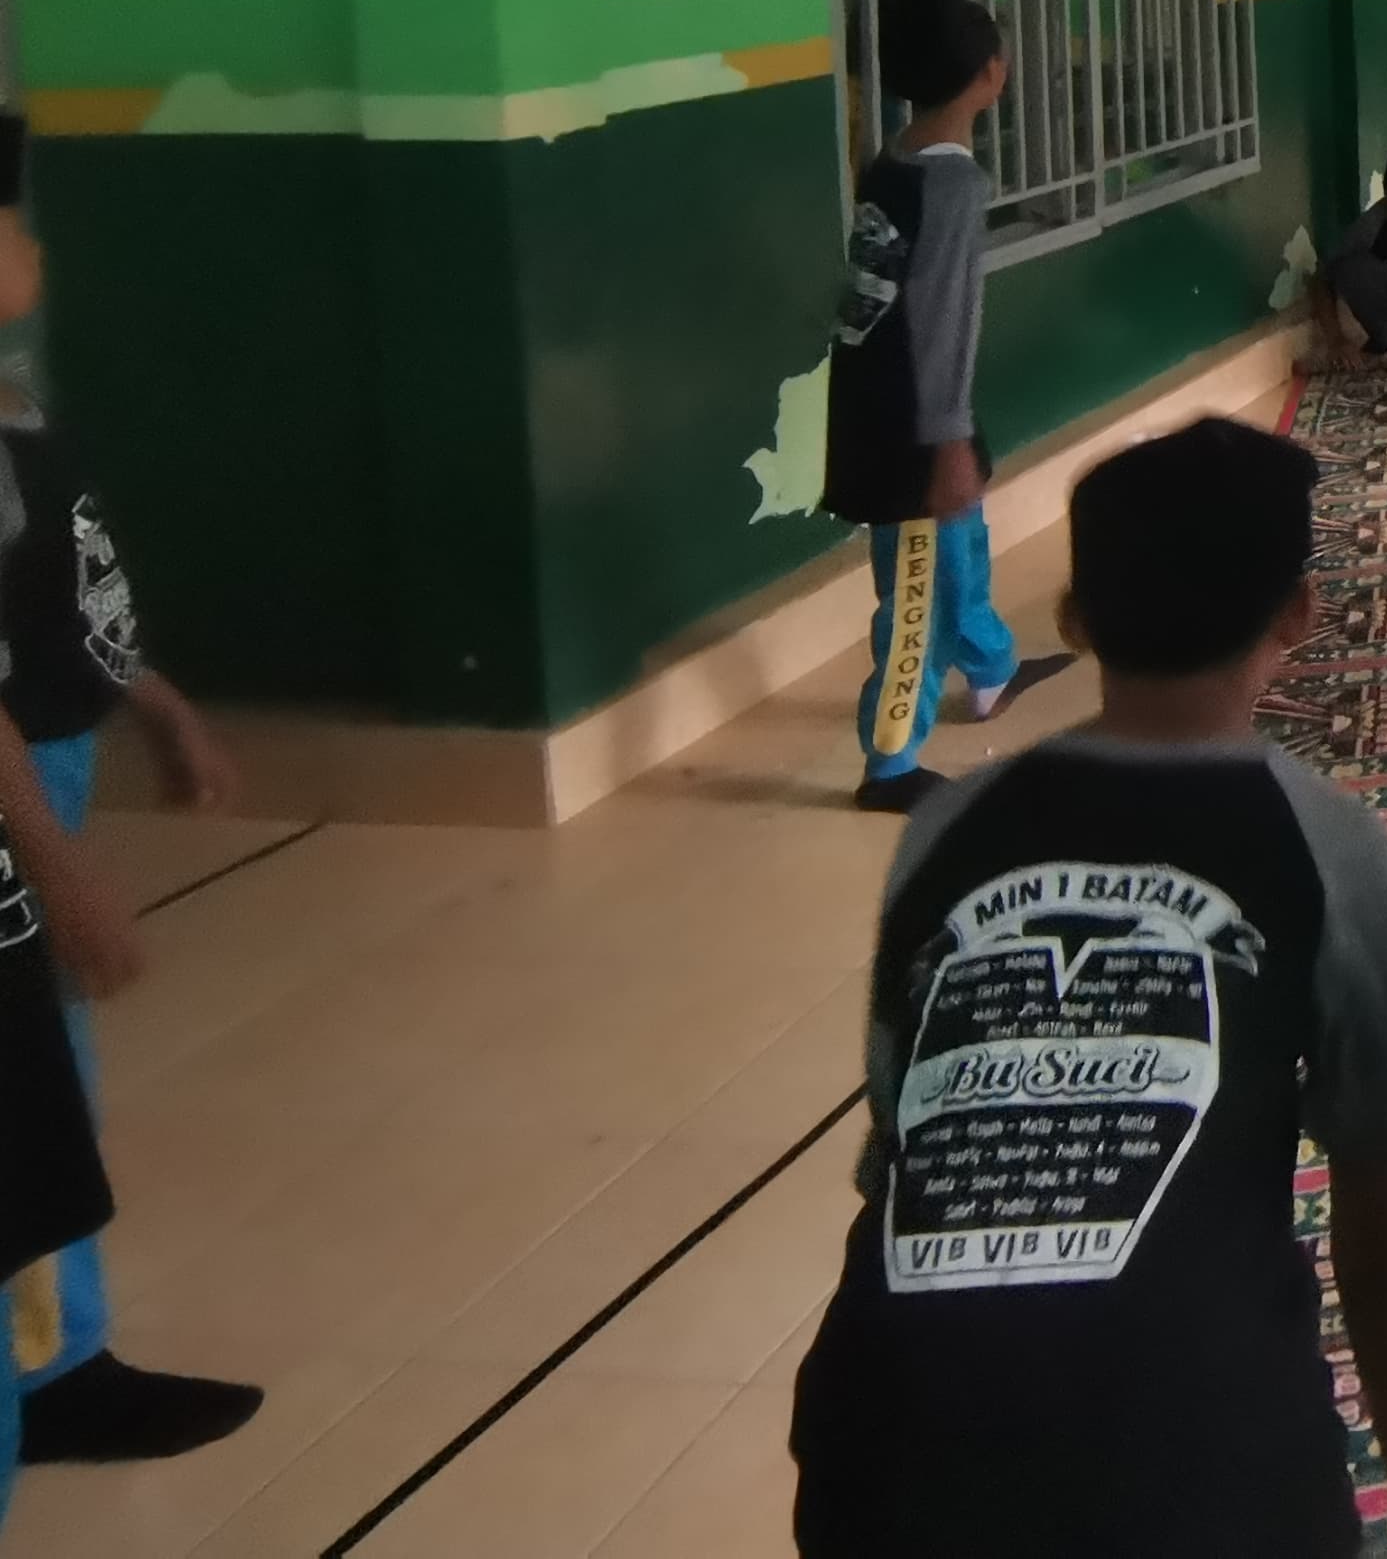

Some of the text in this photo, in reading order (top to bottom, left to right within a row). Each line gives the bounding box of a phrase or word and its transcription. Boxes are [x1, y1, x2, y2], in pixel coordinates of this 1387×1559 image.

[888, 534, 930, 721] BENGKONG
[973, 876, 1043, 927] MIN
[1081, 872, 1209, 920] BATAM
[945, 1042, 1159, 1099] Bu Suci
